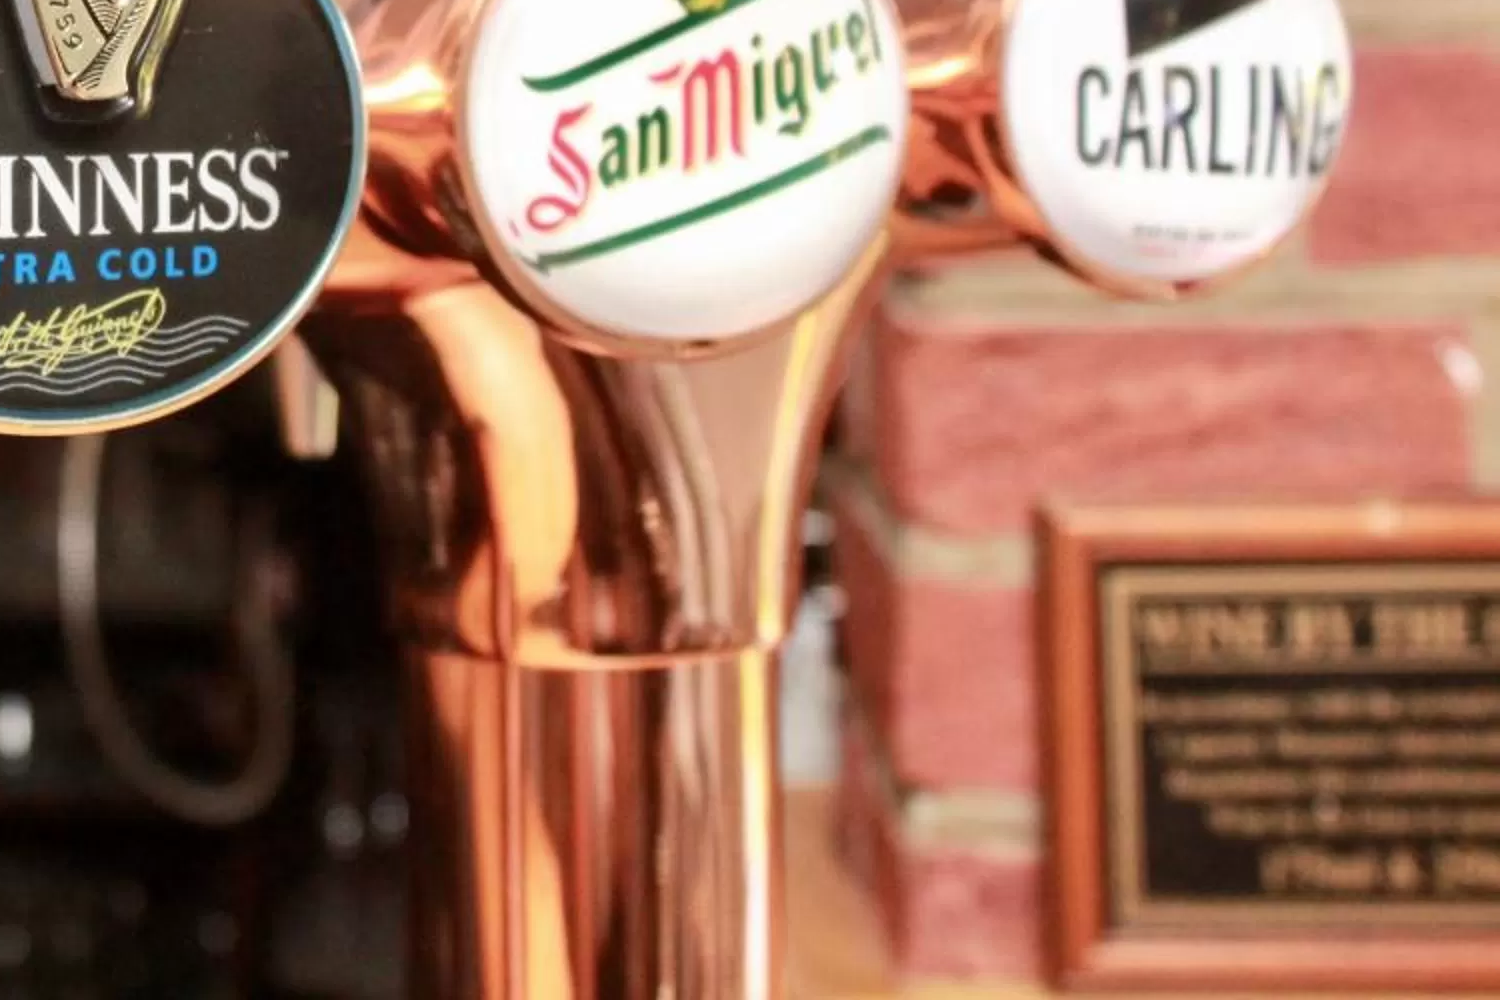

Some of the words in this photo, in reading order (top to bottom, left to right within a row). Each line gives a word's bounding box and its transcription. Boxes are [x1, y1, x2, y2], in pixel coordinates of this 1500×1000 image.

[524, 104, 671, 233] San
[1075, 63, 1342, 180] CARLING
[96, 245, 219, 281] COLD
